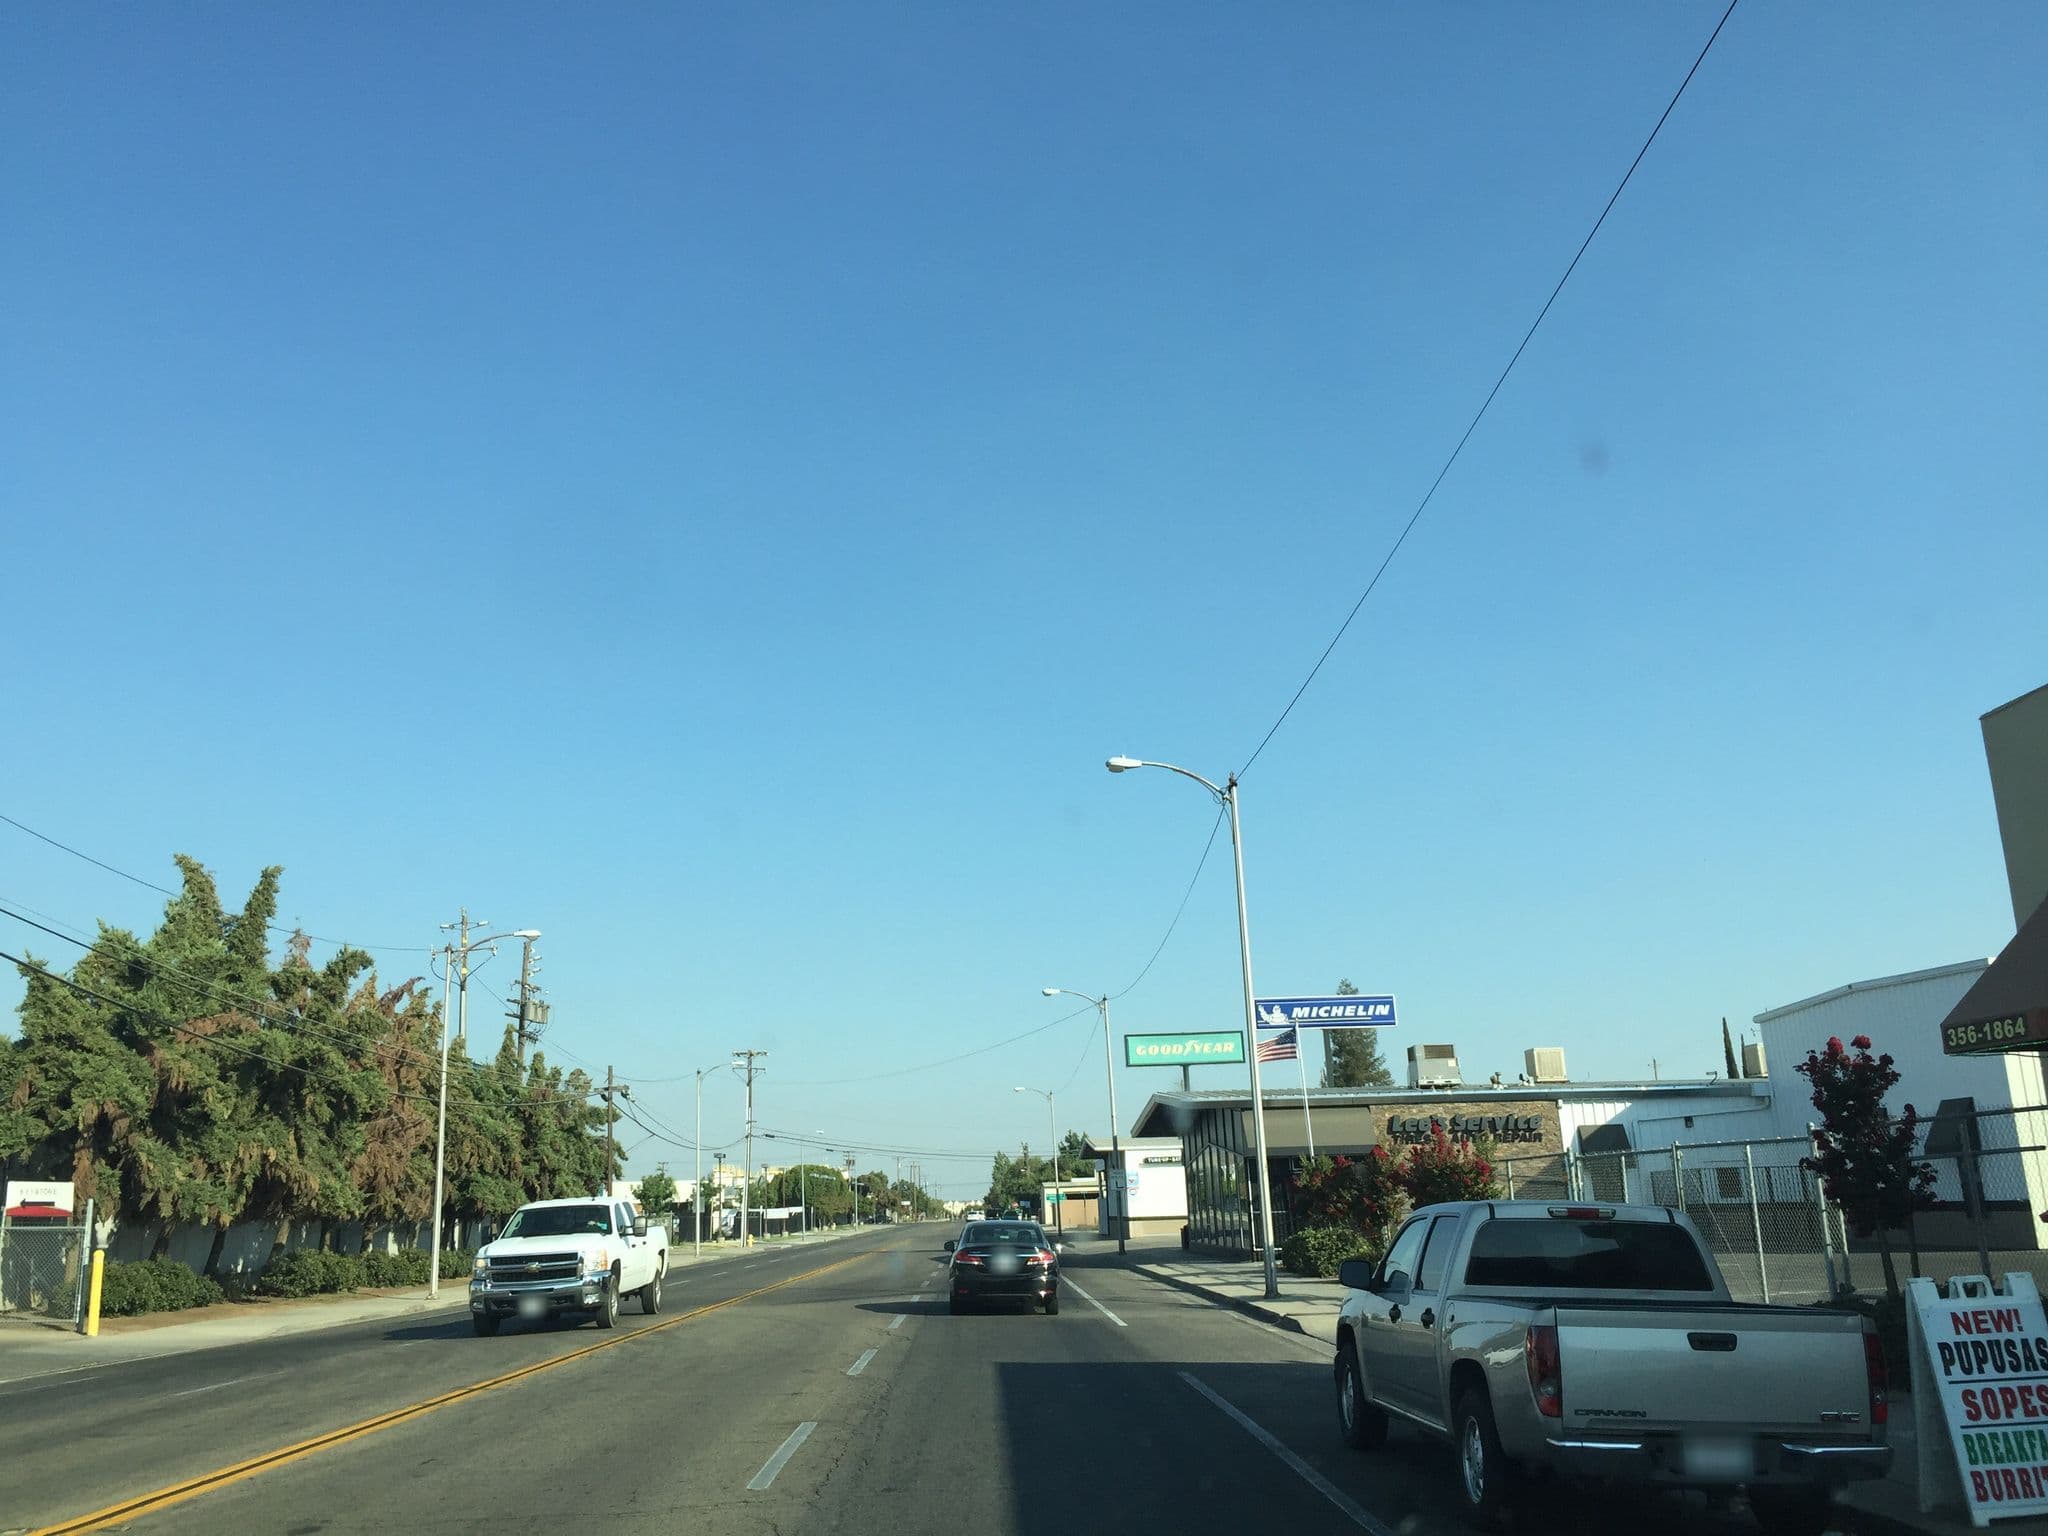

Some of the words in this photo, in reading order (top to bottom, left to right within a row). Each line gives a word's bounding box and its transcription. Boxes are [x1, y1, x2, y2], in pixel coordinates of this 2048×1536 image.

[1291, 1004, 1390, 1018] MICHELIN
[1947, 1017, 2025, 1046] 356-1864
[1136, 1040, 1235, 1056] GOODYEAR
[1450, 1113, 1543, 1133] Service
[1950, 1309, 2024, 1335] NEW!
[1937, 1337, 2048, 1376] PUPUSAS
[1961, 1384, 2048, 1421] SOPES
